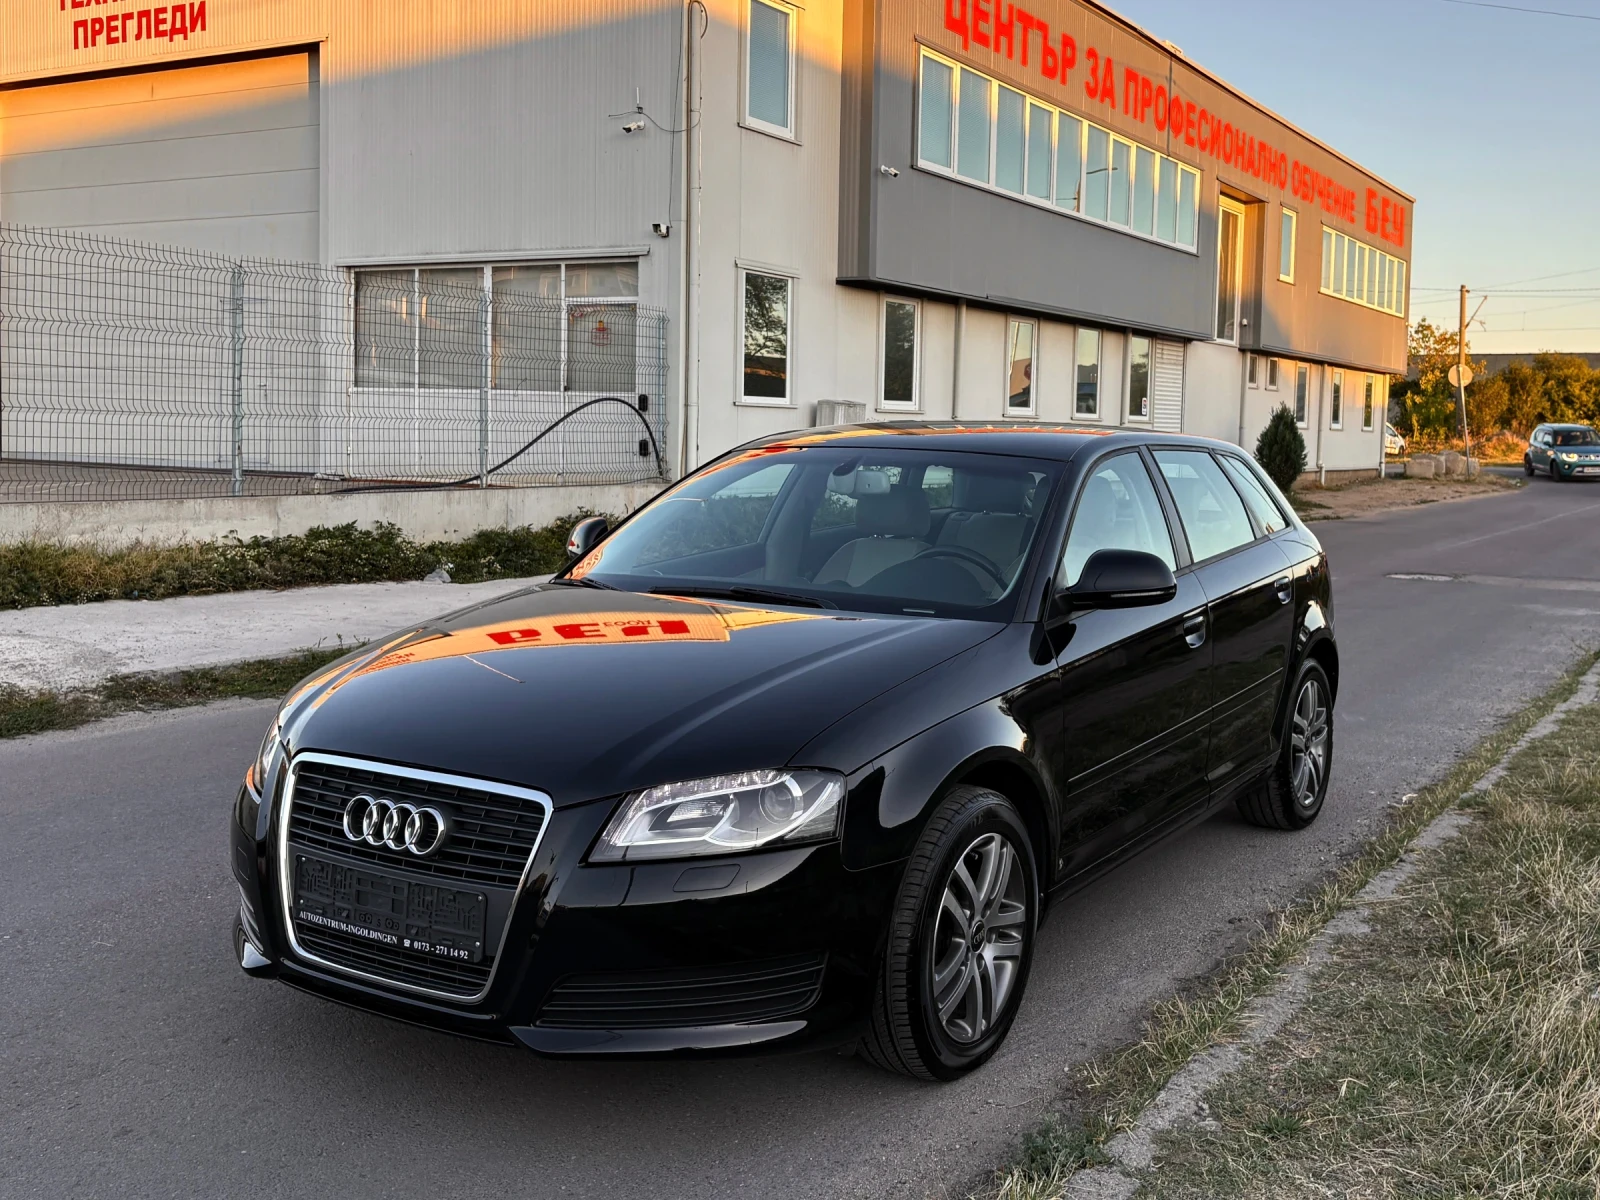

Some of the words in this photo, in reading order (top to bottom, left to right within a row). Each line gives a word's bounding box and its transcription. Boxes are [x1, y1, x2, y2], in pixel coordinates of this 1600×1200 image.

[73, 1, 207, 50] ПРЕГЛЕДИ
[944, 0, 1078, 86] ЦЕНТЪР
[1084, 46, 1117, 110] ЗА
[1123, 66, 1289, 191] ПРОФЕСИОНАЛНО
[1291, 159, 1357, 225] ОБУЧЕНИЕ
[299, 910, 398, 945] AUTOZENTRUM-INGOLDINGEN
[413, 940, 430, 952] 0173
[435, 945, 448, 956] 271
[450, 948, 458, 957] 14
[459, 950, 469, 960] 92
